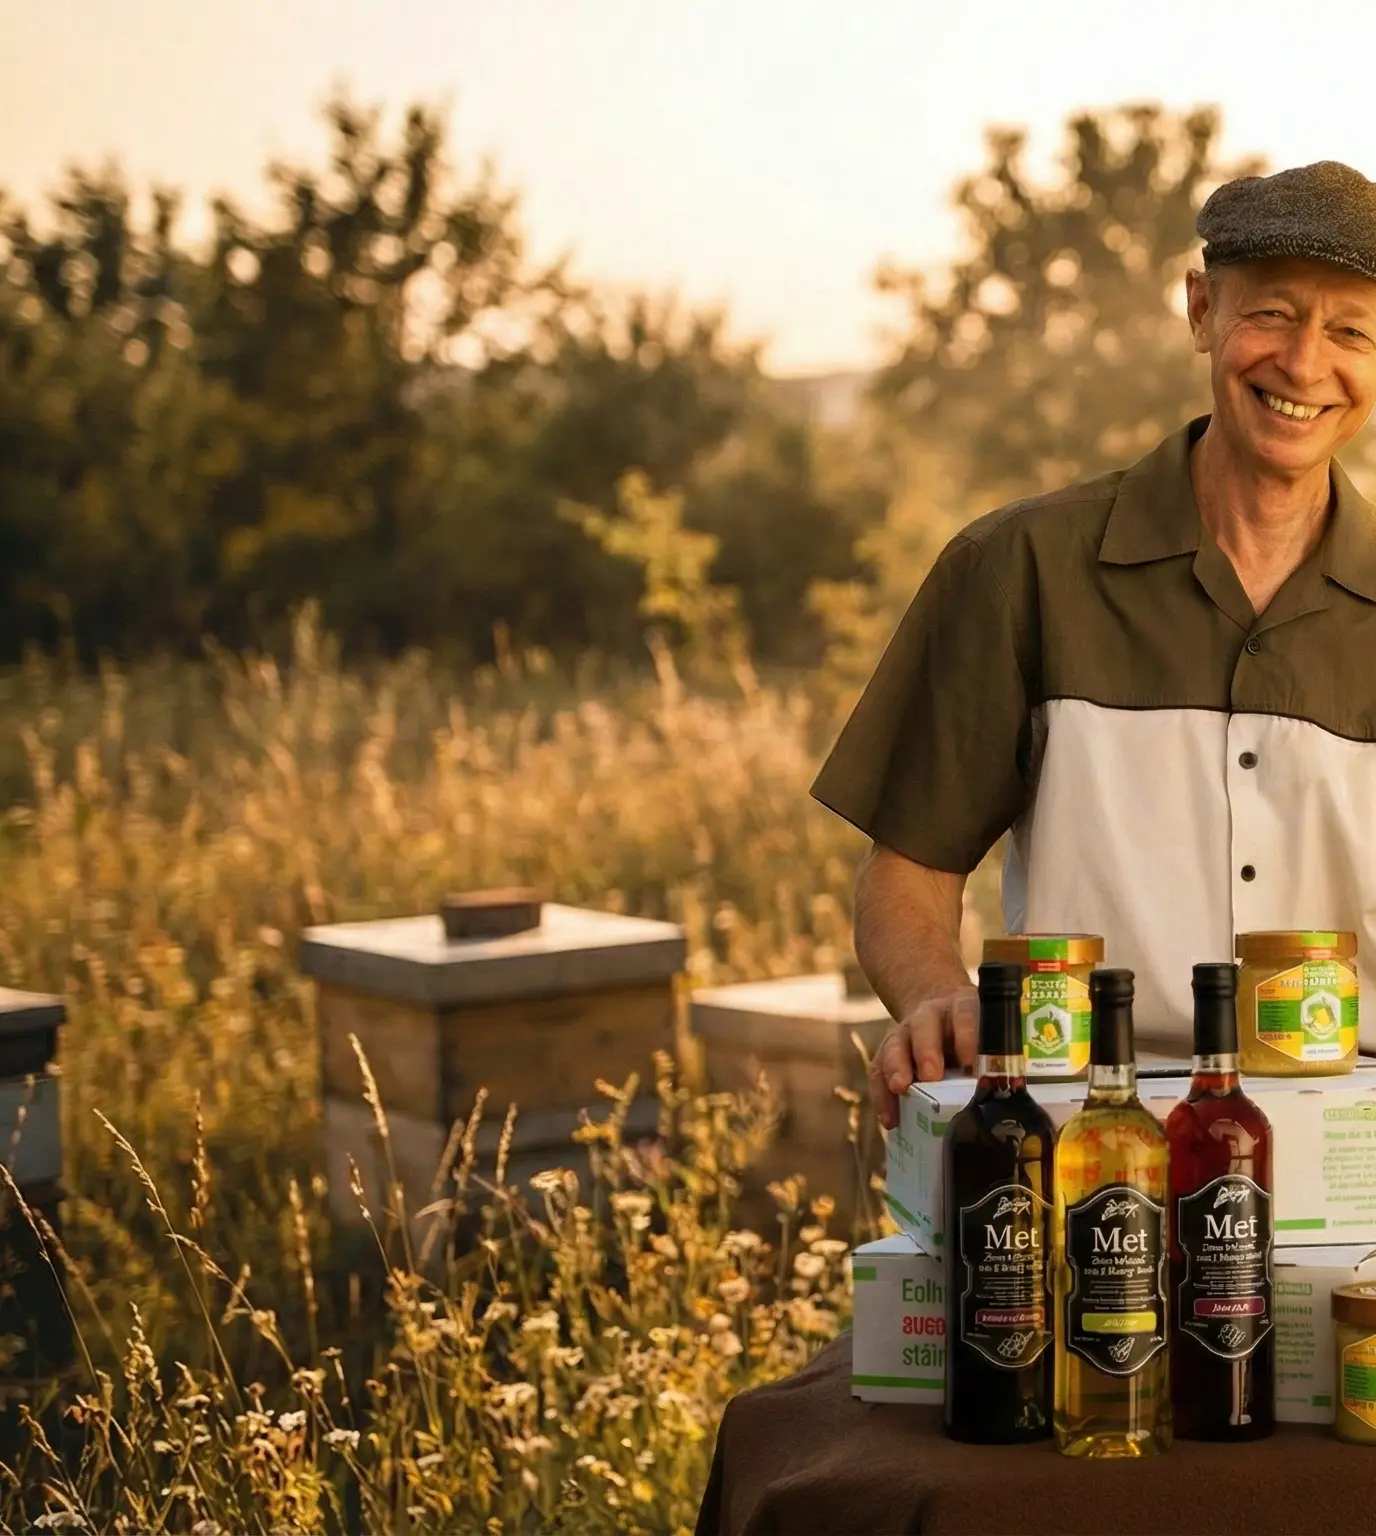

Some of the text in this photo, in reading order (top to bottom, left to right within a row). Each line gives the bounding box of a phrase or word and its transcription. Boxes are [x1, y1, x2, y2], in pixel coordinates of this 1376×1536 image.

[984, 1224, 1040, 1250] Met
[1204, 1214, 1258, 1239] Met
[1091, 1227, 1148, 1253] Met
